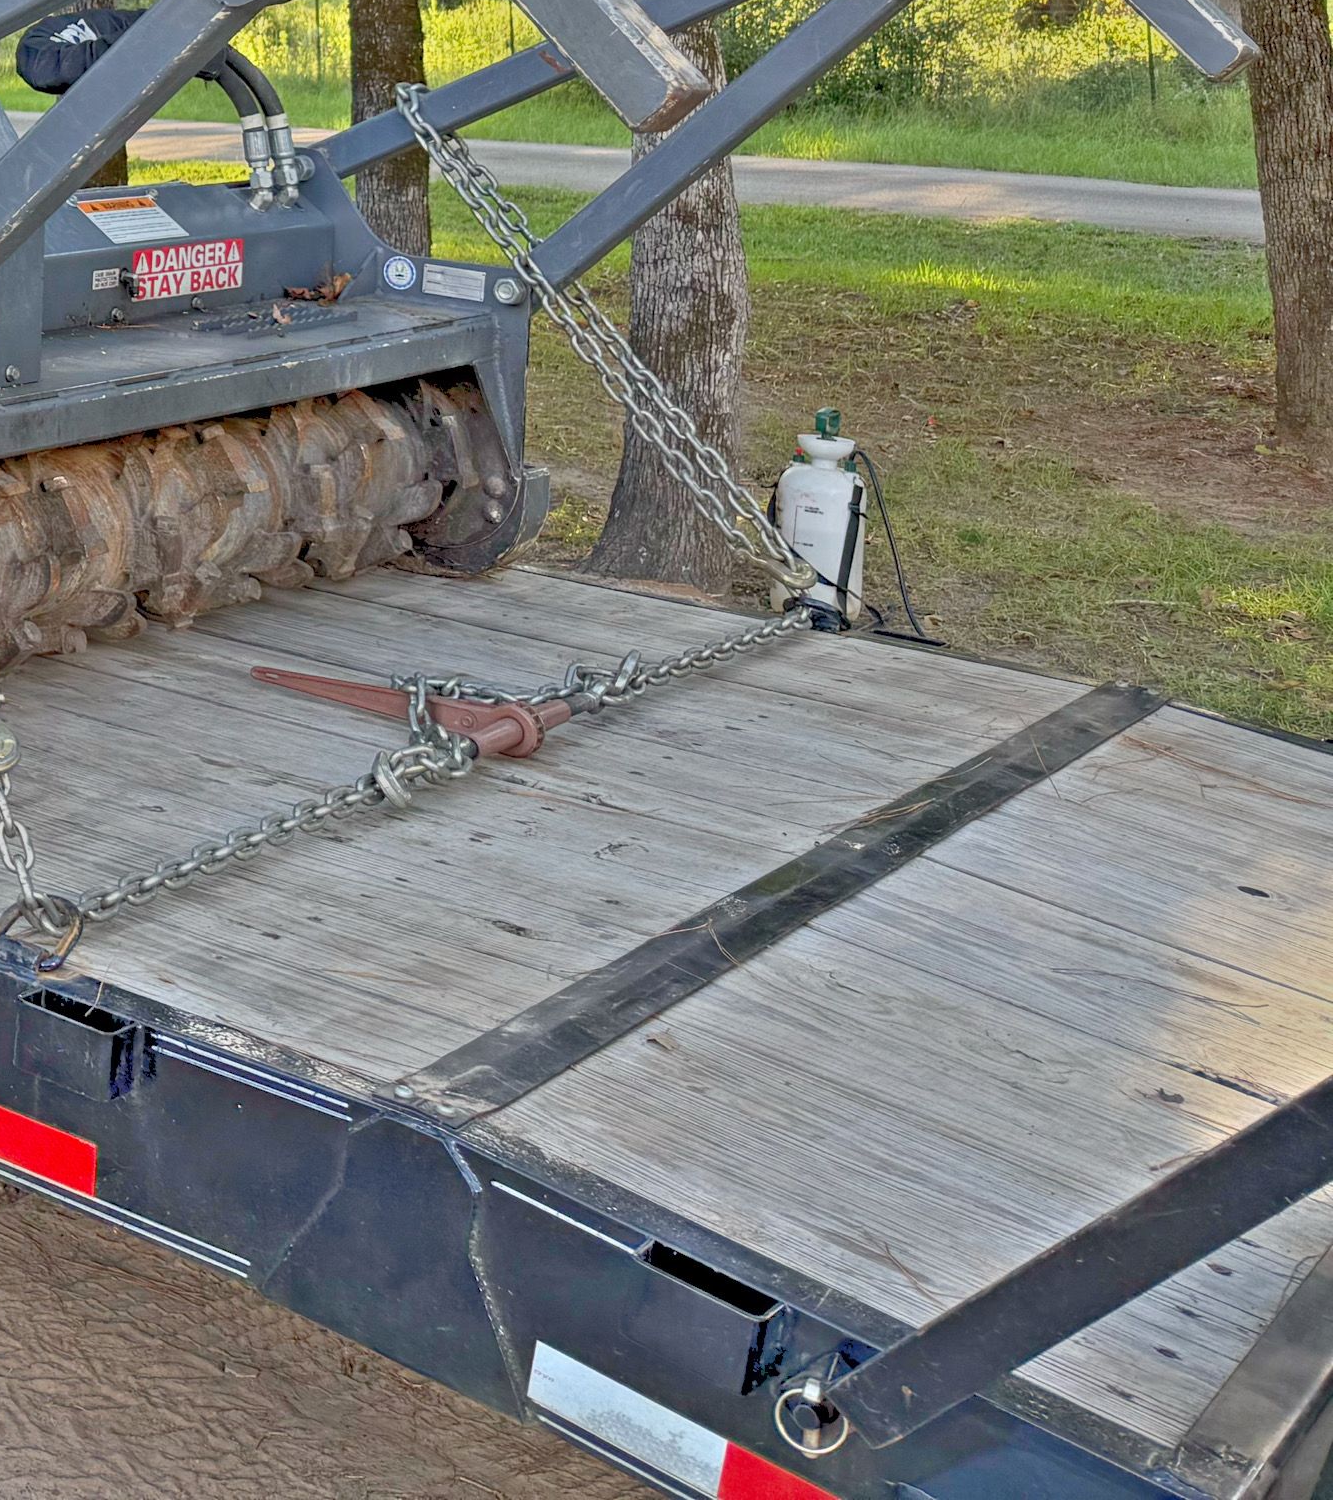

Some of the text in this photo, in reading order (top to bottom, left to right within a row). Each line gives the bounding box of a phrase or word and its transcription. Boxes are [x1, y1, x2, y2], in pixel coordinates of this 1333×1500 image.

[151, 241, 227, 273] DANGER
[135, 264, 240, 300] STAY BACK
